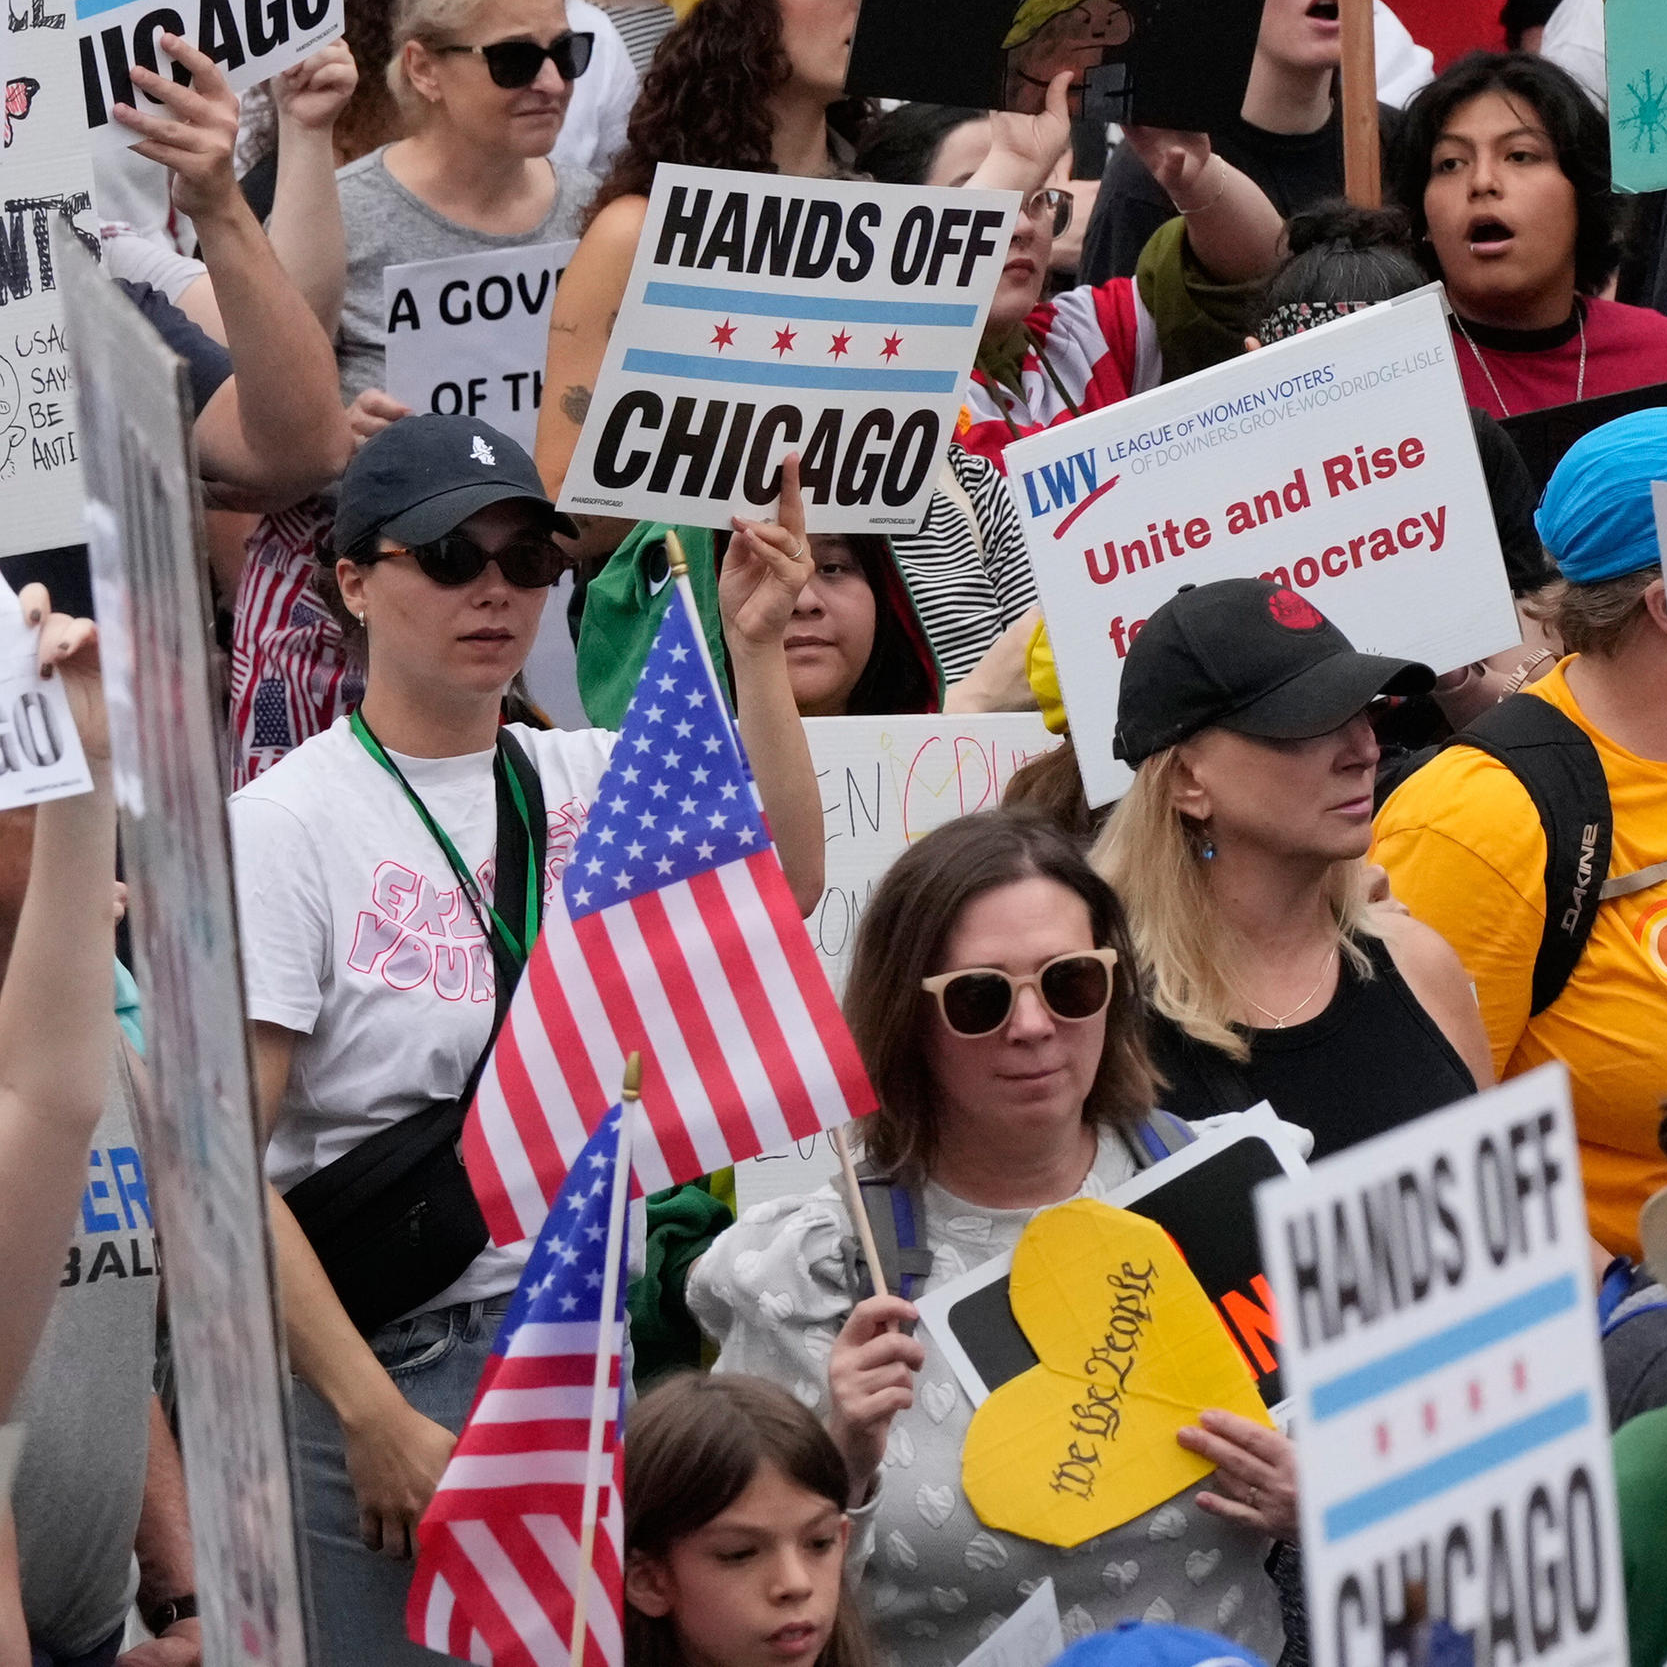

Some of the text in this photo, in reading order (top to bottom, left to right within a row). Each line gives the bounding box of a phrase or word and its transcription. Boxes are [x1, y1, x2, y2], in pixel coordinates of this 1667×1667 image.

[653, 185, 1005, 287] HANDS OFF
[593, 389, 940, 508] CHICAGO
[1107, 423, 1175, 464] LEAGUE
[1175, 417, 1197, 438] OF
[1198, 390, 1268, 429] WOMEN
[1156, 345, 1446, 468] DOWNERS GROVE-WOODRIDGE-LISLE
[1021, 447, 1100, 519] LWV
[1083, 434, 1427, 587] Unite and Rise
[1561, 822, 1600, 936] DAKINE
[1286, 1112, 1562, 1349] HANDS OFF
[1084, 1258, 1159, 1394] People
